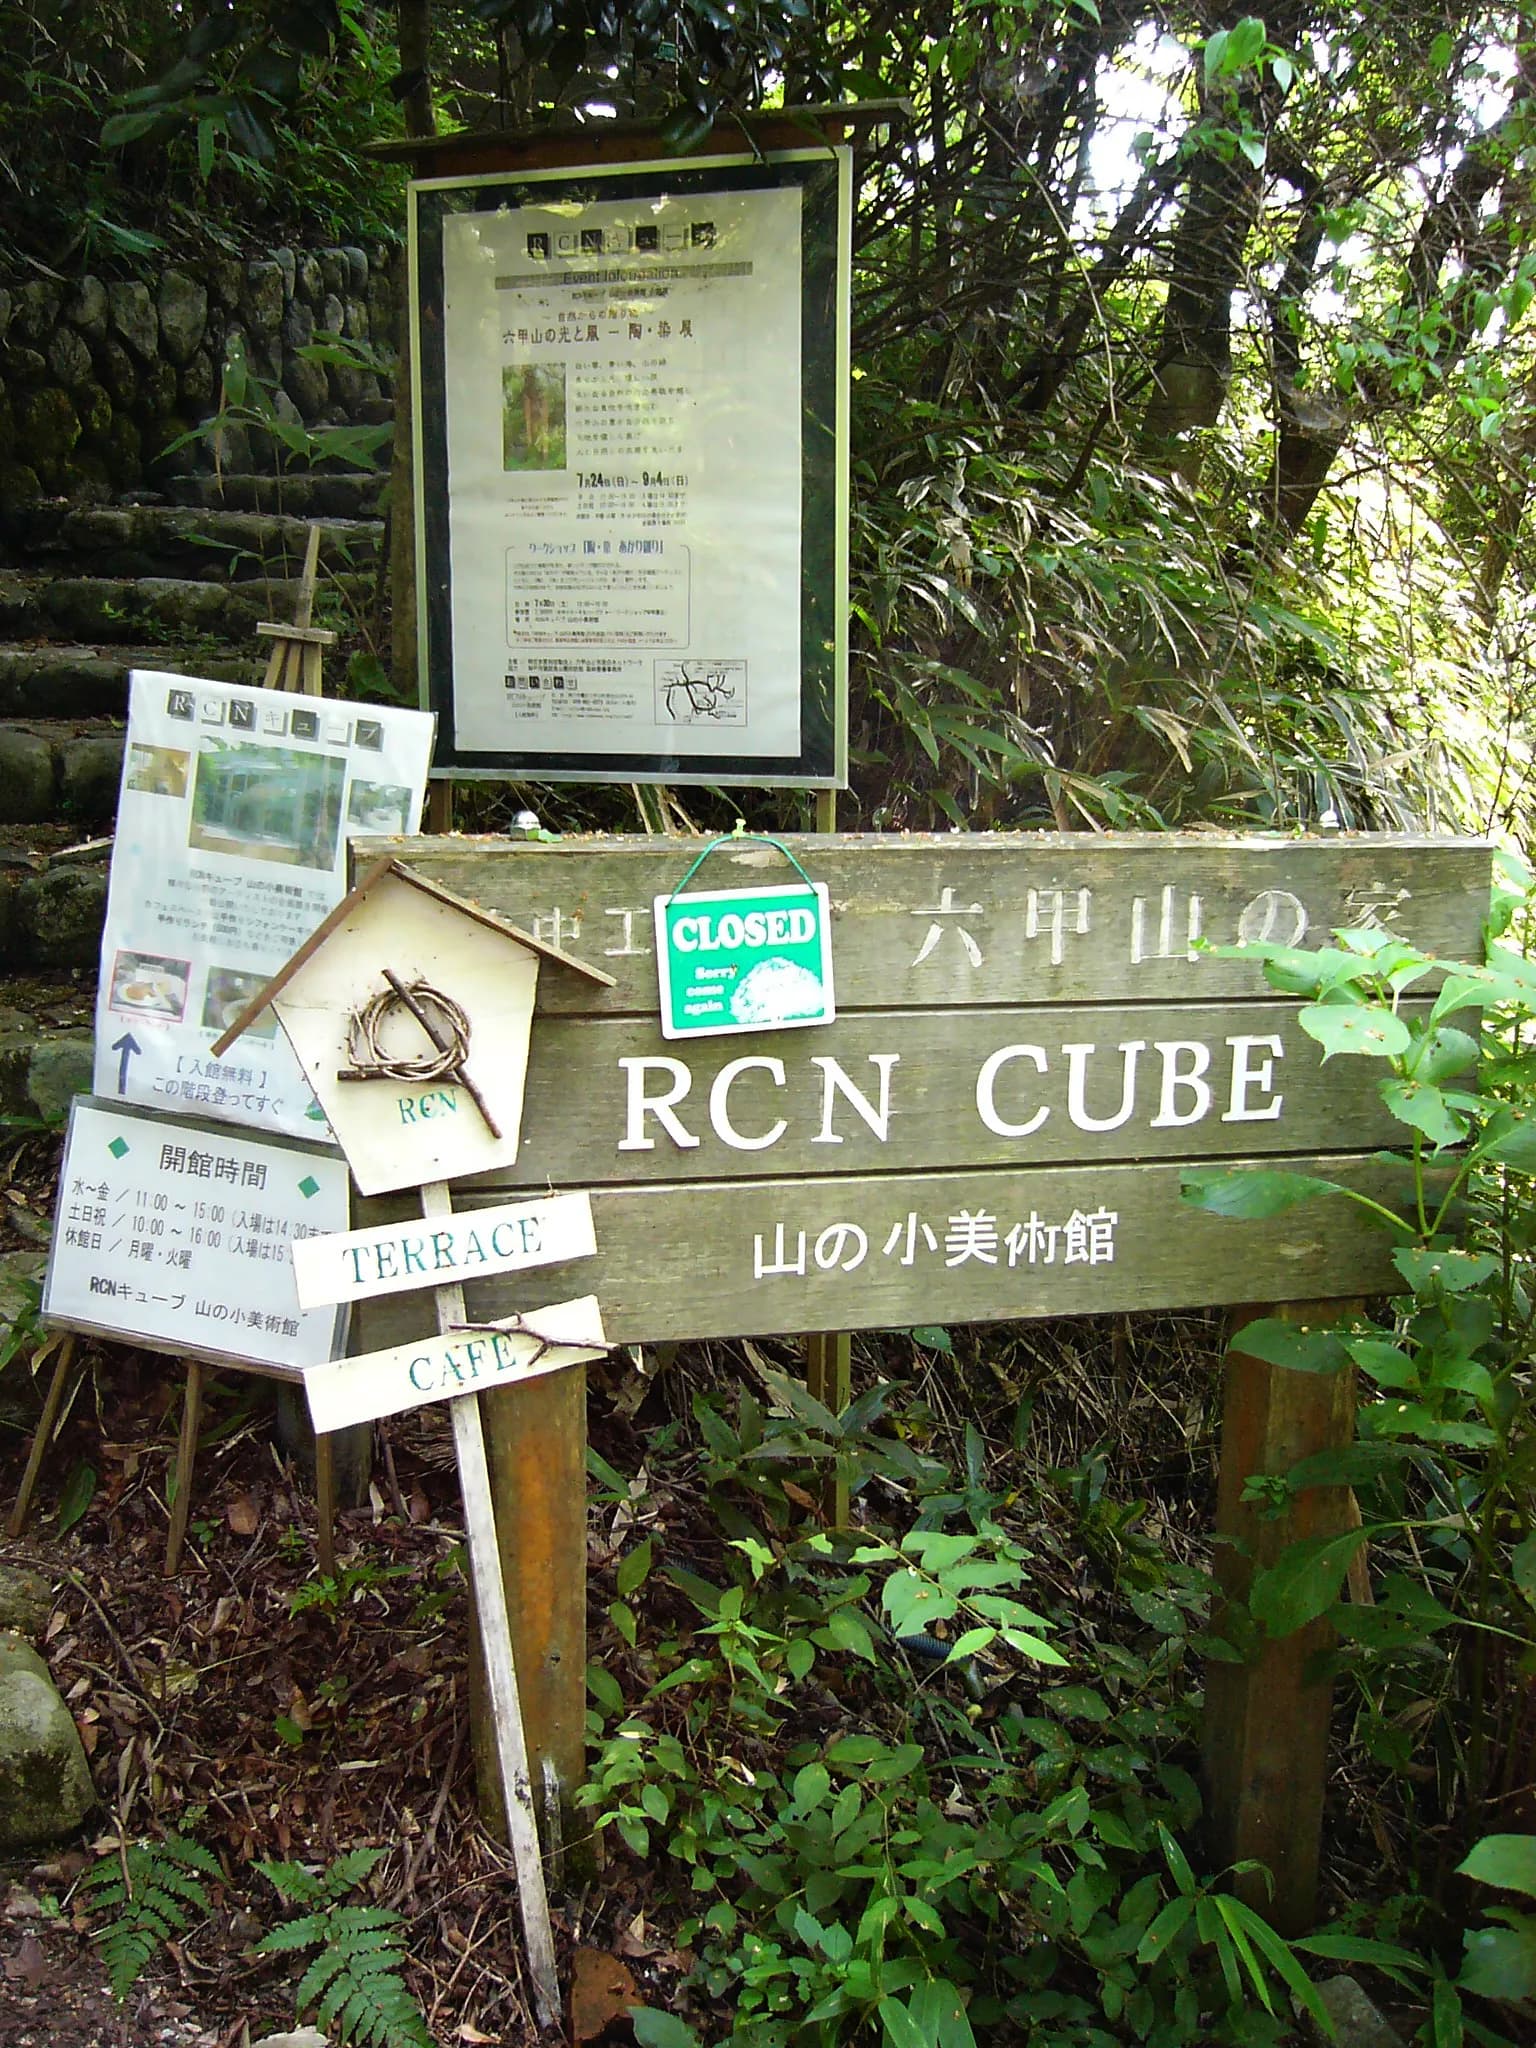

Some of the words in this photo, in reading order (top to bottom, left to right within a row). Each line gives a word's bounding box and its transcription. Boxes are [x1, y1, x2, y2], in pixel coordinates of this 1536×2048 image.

[564, 271, 600, 284] Event
[502, 324, 600, 345] 六甲山の光と風
[672, 908, 817, 952] CLOSED
[152, 1076, 285, 1115] この階段登ってすぐ
[398, 1088, 457, 1123] RCN
[618, 1054, 900, 1150] RCN
[976, 1035, 1285, 1137] CUBE
[160, 1143, 268, 1190] 開館時間
[342, 1216, 543, 1283] TERRACE
[754, 1207, 1119, 1279] 山の小美術館
[195, 1300, 300, 1337] 山の小美術館
[409, 1333, 517, 1391] CAFE
